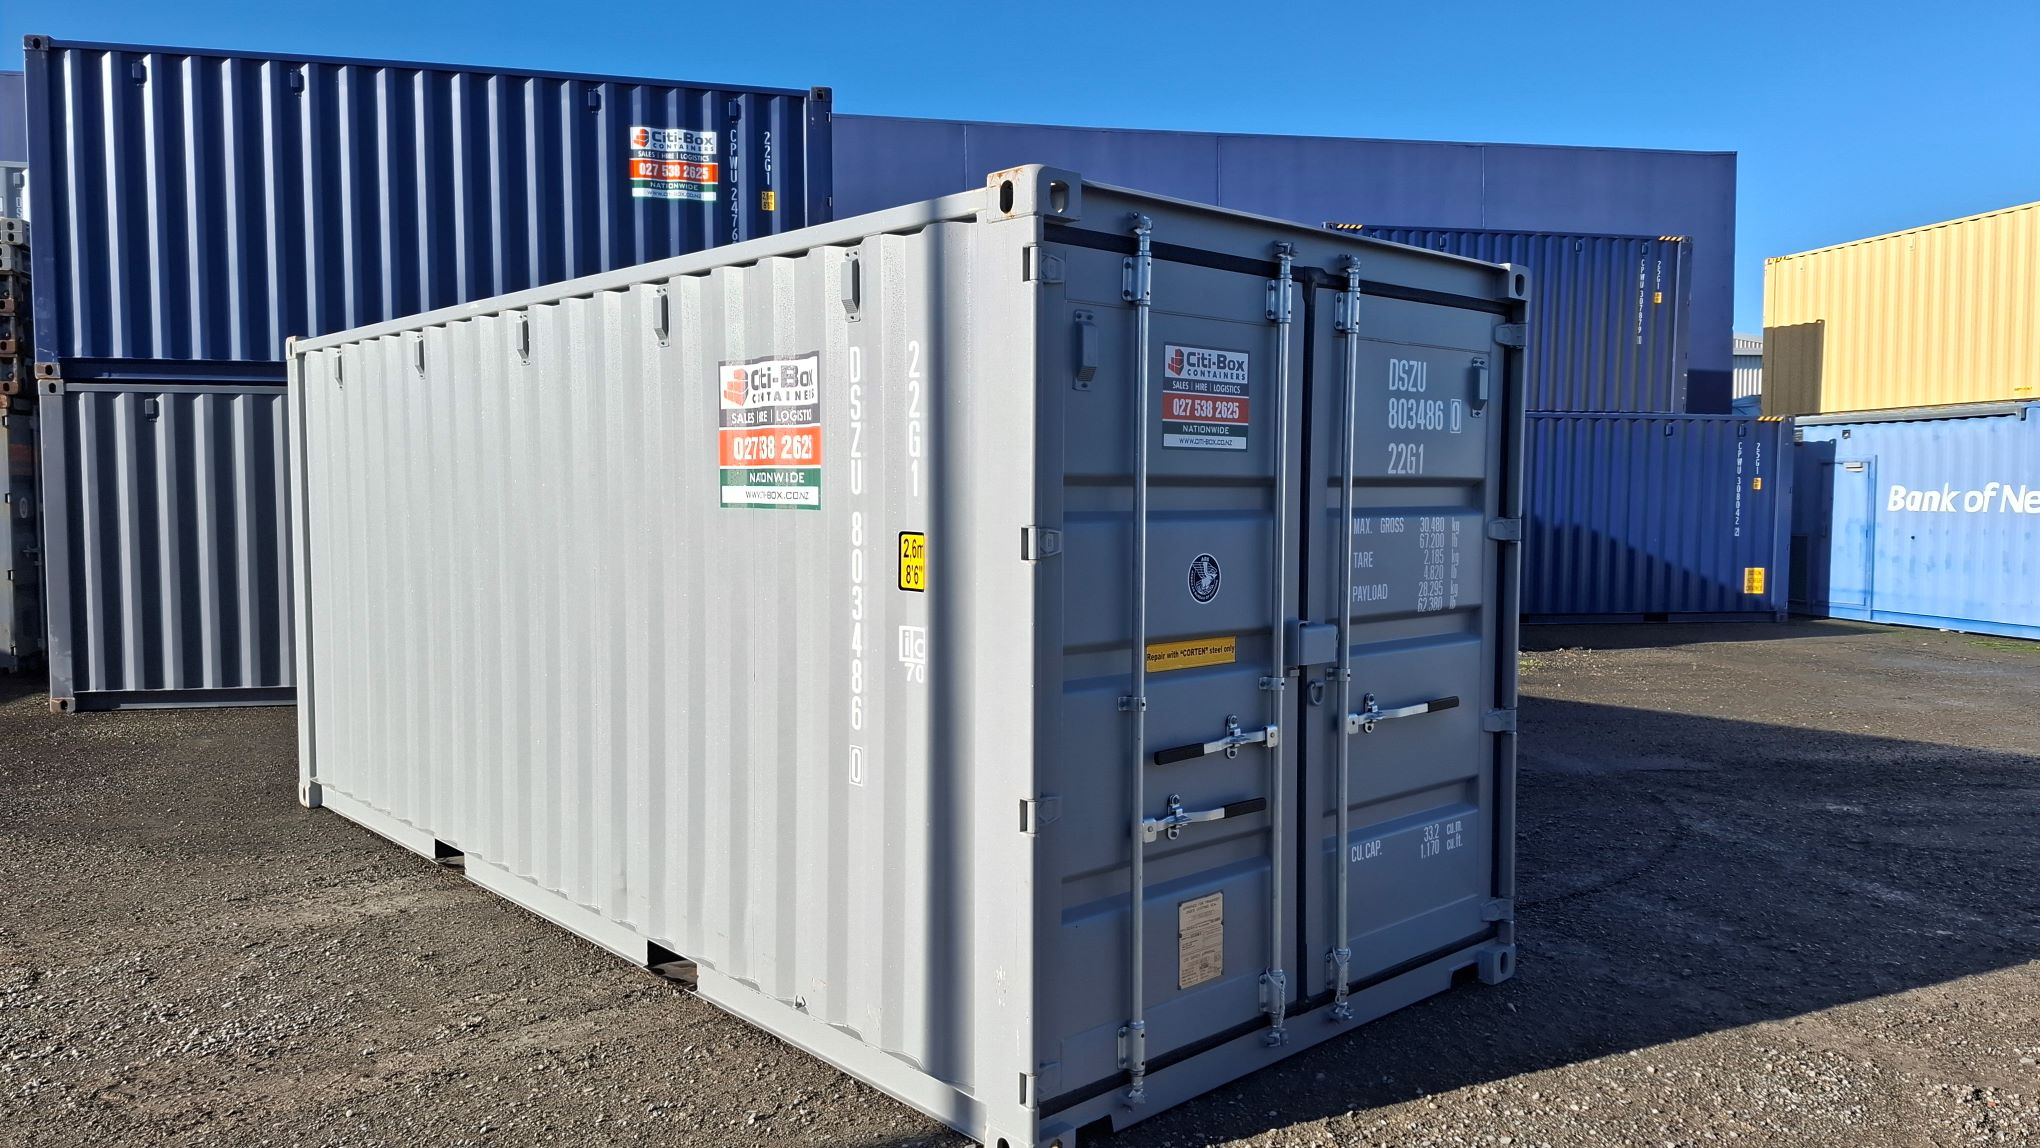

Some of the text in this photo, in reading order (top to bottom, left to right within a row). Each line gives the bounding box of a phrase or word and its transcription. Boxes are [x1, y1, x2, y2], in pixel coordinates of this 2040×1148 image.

[651, 130, 713, 145] Citi-Box
[653, 143, 714, 152] CONTAINERS
[763, 131, 771, 186] 22G1
[639, 163, 709, 179] 027 538 2625
[650, 182, 698, 190] NATIONWIDE
[729, 129, 739, 243] CPWU 2476
[1187, 351, 1245, 373] Citi-Box
[1187, 369, 1246, 381] CONTAINERS
[1389, 358, 1427, 392] DSZU
[1172, 381, 1241, 394] SALES HIRE LOGISTICS
[731, 412, 755, 424] SALES
[908, 340, 920, 497] 22G1
[1173, 398, 1239, 419] 027 538 2625
[1388, 397, 1460, 432] 803486 0
[1182, 425, 1230, 435] NATIONWIDE
[733, 436, 758, 460] 027
[759, 435, 775, 460] 38
[1388, 442, 1424, 475] 22G1
[1887, 481, 1961, 512] Bank
[1963, 481, 2000, 513] of
[1353, 516, 1460, 535] MAX. GROSS 30.480 kg
[1420, 532, 1458, 548] 67.200 lb
[850, 346, 863, 784] DSZU 803486 0
[1353, 552, 1374, 568] TARE
[1451, 548, 1459, 566] kg
[1424, 564, 1458, 580] 4.820 lb
[1352, 580, 1459, 602] PAYLOAD 28.295 kg
[1449, 596, 1456, 609] lb
[1147, 652, 1166, 662] Repair
[1166, 650, 1179, 659] with
[1209, 645, 1223, 654] steel
[1223, 644, 1235, 654] only
[904, 663, 924, 683] 70
[1351, 844, 1364, 862] CU.
[1365, 840, 1383, 858] CAP.
[1423, 823, 1440, 842] 33.2
[1420, 839, 1440, 859] 1.170
